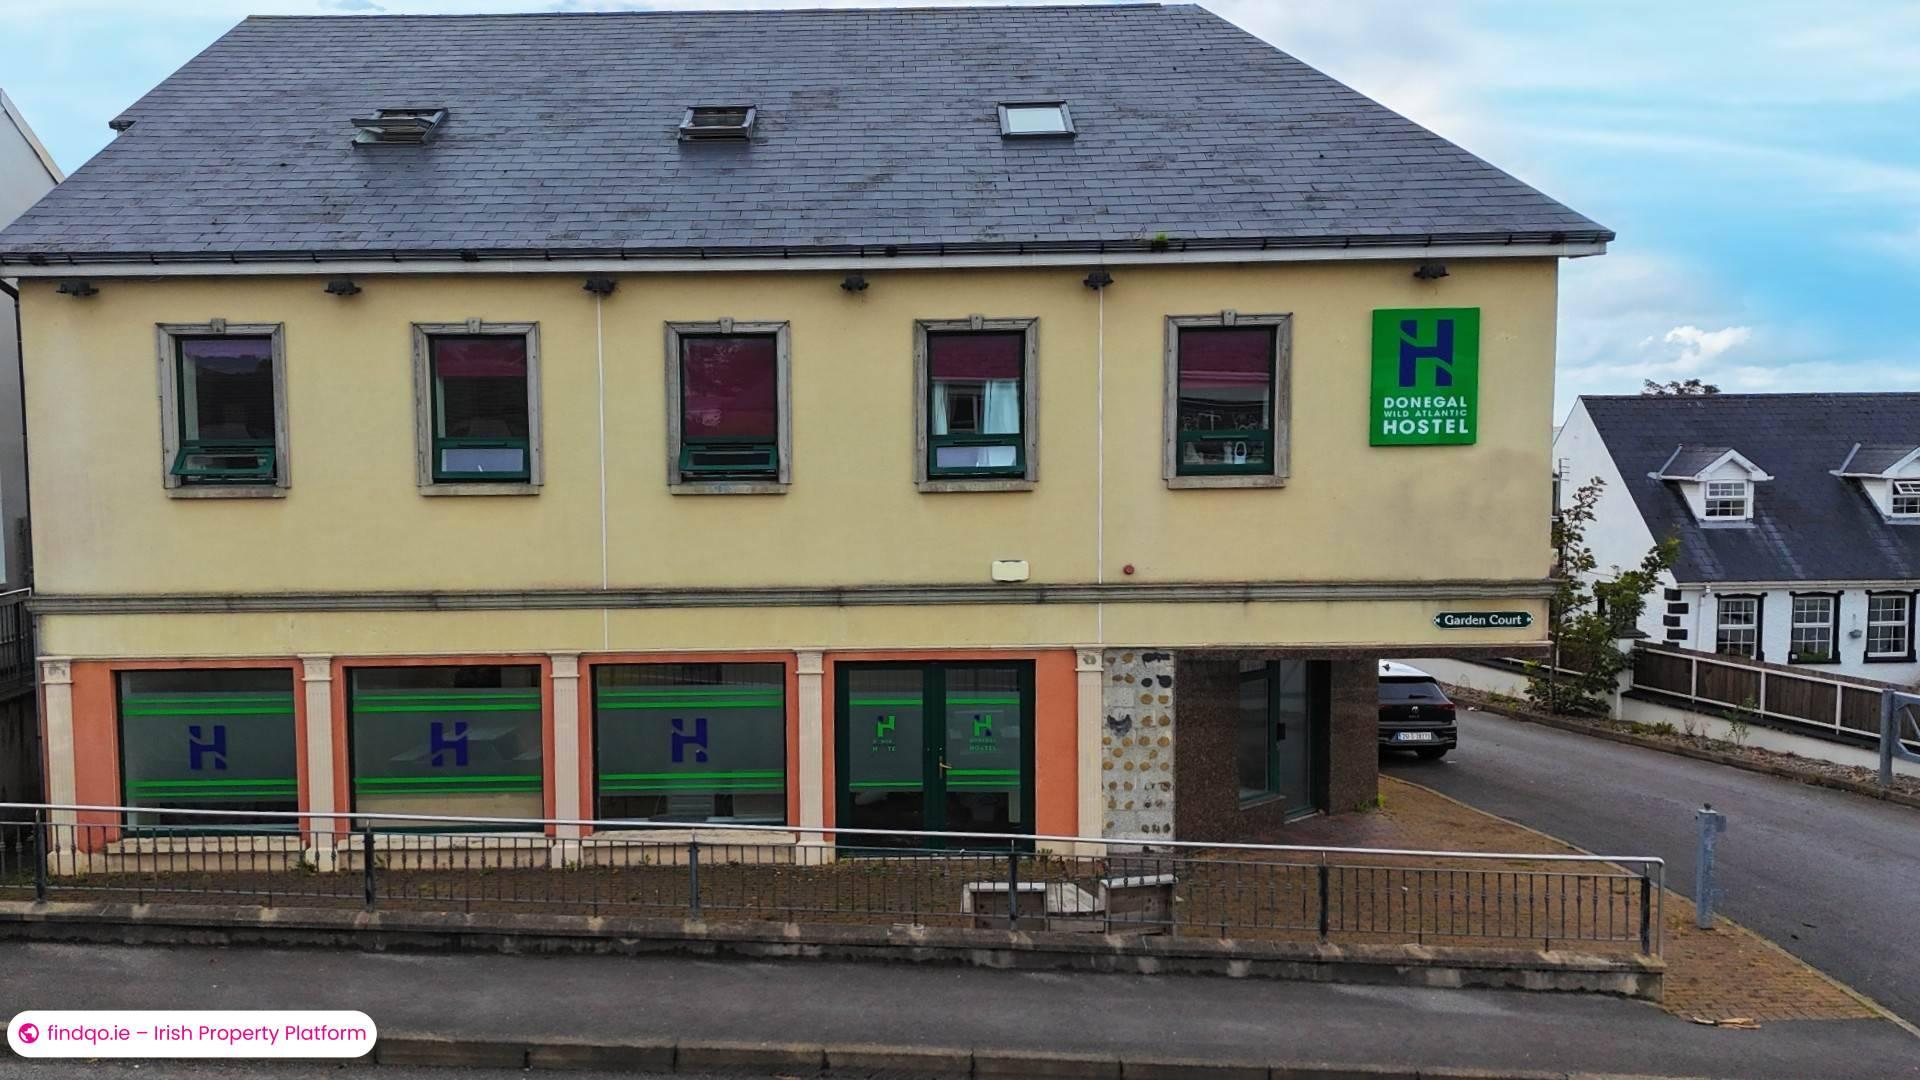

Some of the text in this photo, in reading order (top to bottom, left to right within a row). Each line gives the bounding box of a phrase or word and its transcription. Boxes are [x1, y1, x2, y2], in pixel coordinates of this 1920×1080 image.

[1383, 396, 1468, 409] DONEGAL
[1383, 409, 1468, 418] WILD ATLANTIC
[1383, 419, 1469, 435] HOSTEL
[1444, 614, 1522, 625] Garden Court
